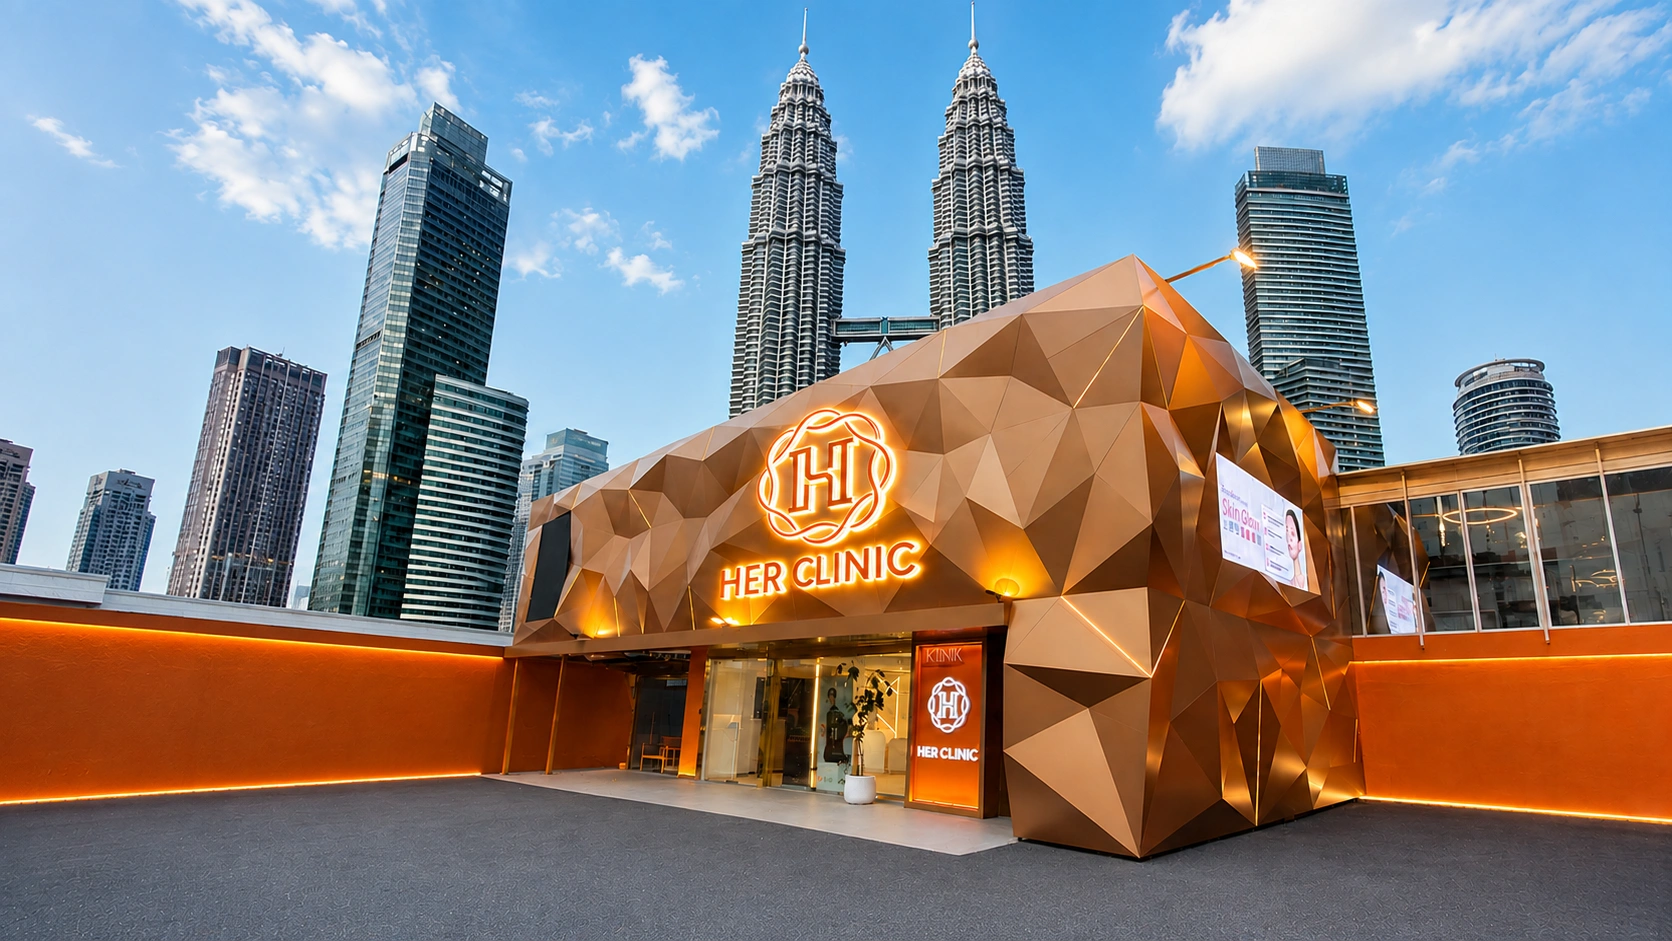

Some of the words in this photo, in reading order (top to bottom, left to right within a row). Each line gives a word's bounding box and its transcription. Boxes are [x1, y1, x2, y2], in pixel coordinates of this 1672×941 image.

[789, 437, 857, 513] H
[1222, 498, 1240, 522] Skin
[720, 562, 783, 599] HER
[792, 542, 916, 587] CLINIC
[937, 691, 960, 719] H
[917, 745, 939, 759] HER
[939, 747, 979, 762] CLINIC
